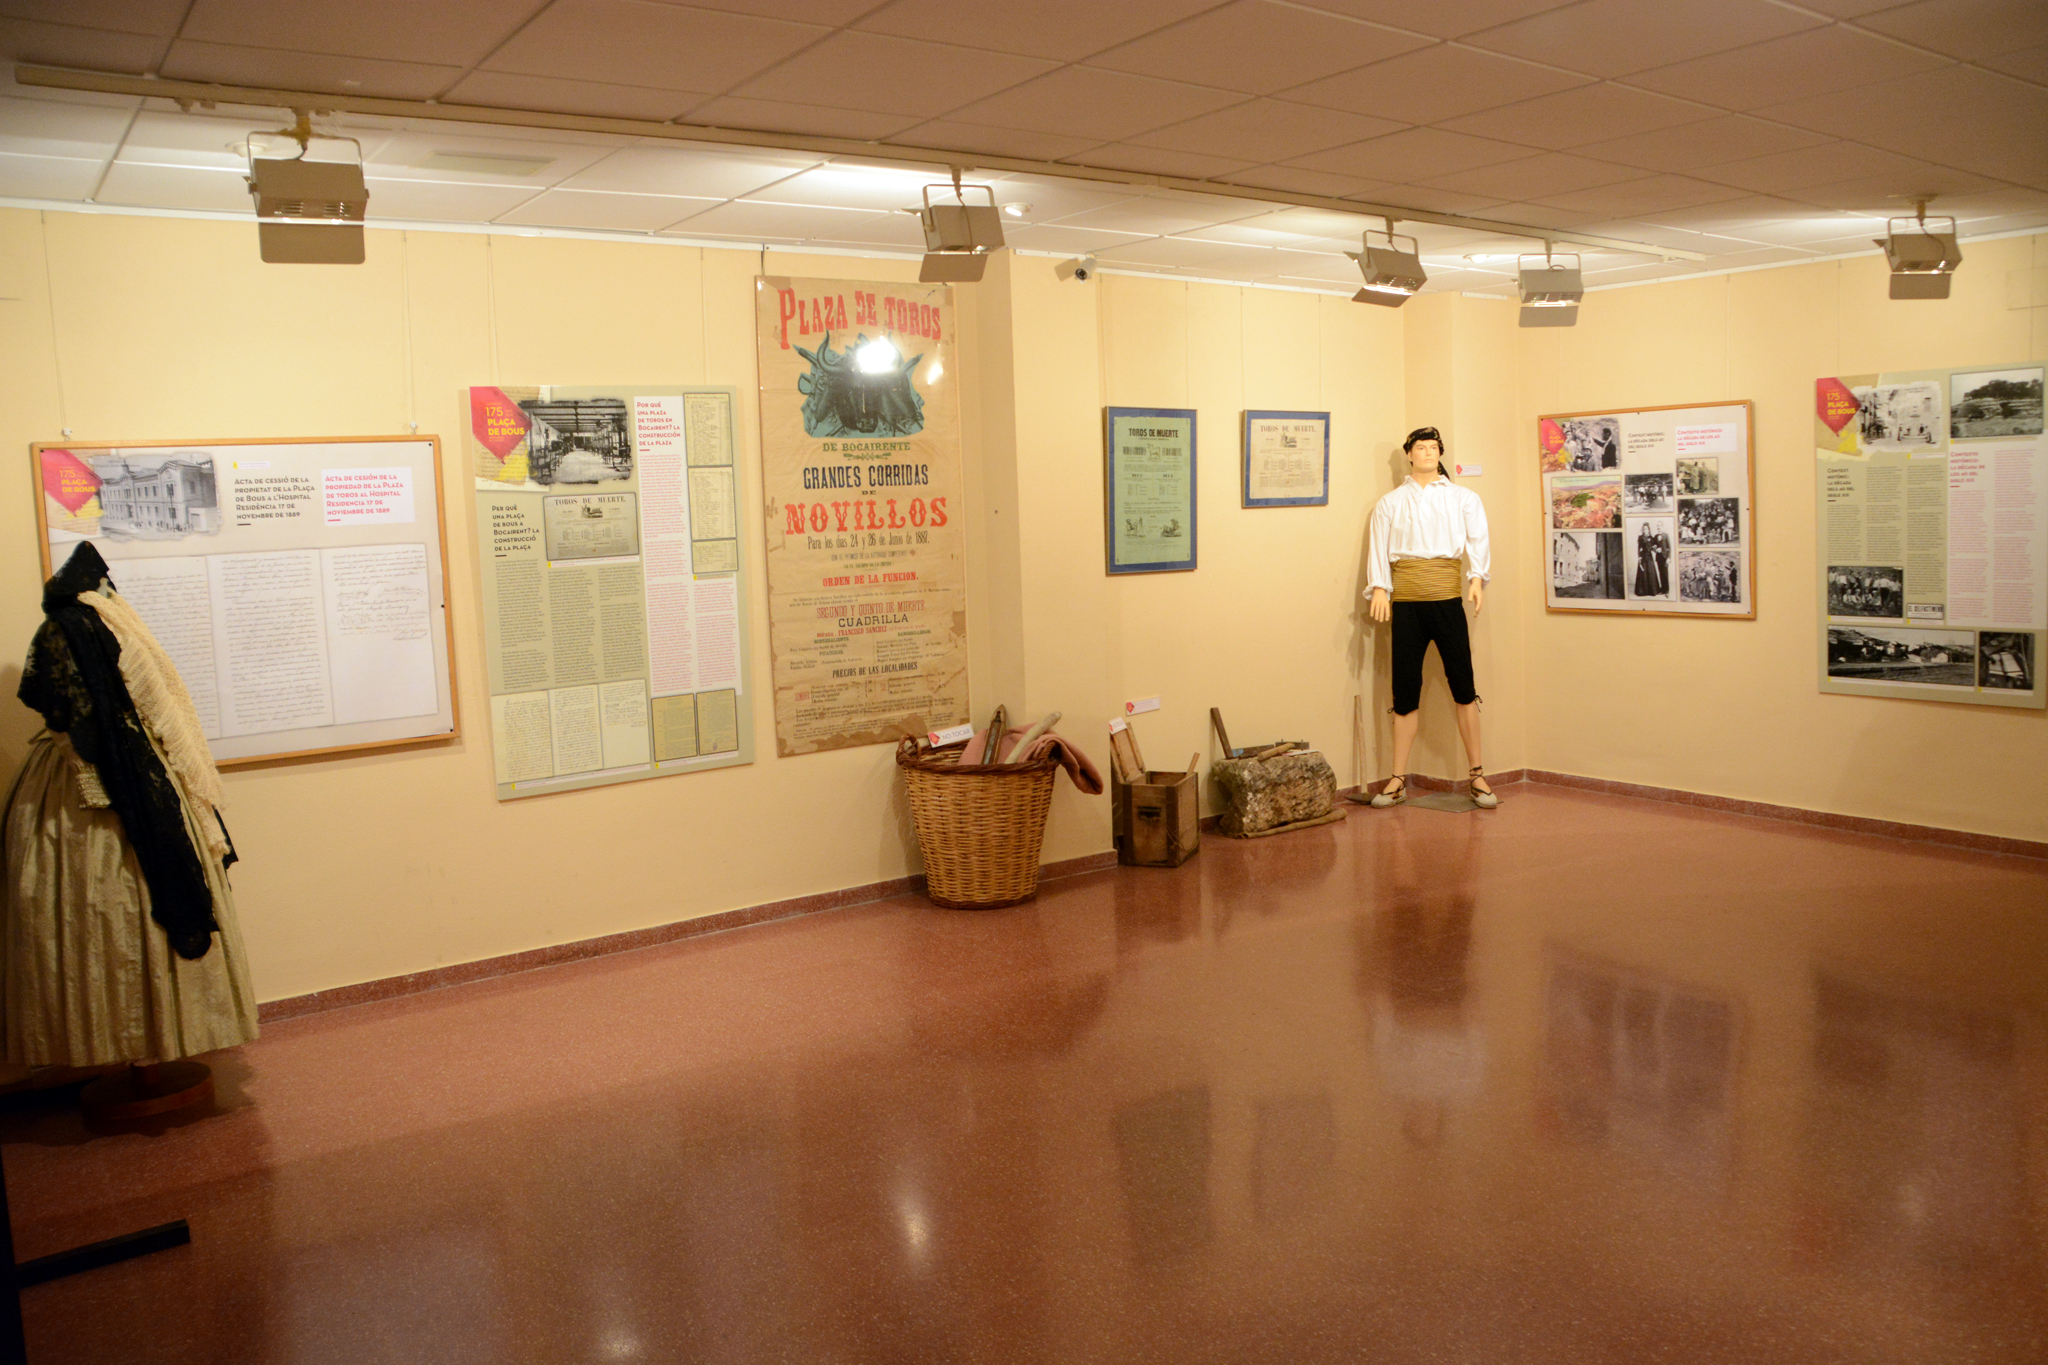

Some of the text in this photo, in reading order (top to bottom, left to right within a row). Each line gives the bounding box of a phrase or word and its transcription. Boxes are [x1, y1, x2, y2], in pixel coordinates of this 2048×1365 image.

[780, 288, 941, 349] PLAZA DE TOROS
[1827, 392, 1841, 401] 175
[485, 406, 504, 417] 175
[1837, 407, 1856, 415] BOUS
[487, 418, 516, 427] PLAÇA
[488, 427, 525, 436] DE BOUS
[1129, 428, 1179, 438] TOROS DE MUERTE
[823, 442, 910, 451] DE BOCAIRENTE
[59, 469, 76, 478] 175
[354, 473, 378, 481] CESIÓN
[803, 464, 929, 489] GRANDES CORRIDAS
[265, 476, 289, 484] CESSIÓ
[293, 484, 315, 493] PLAÇA
[236, 503, 276, 511] RESIDÈNCIA
[506, 513, 525, 521] PLAÇA
[785, 497, 948, 535] NOVILLOS
[493, 528, 531, 536] BOCAIRENT?
[494, 535, 537, 544] CONSTRUCCIÓ
[808, 536, 821, 549] Para
[825, 535, 833, 548] los
[851, 534, 859, 547] 24
[862, 537, 866, 550] y
[868, 533, 876, 546] 26
[879, 533, 885, 545] de
[889, 532, 903, 546] Junio
[906, 532, 912, 545] de
[512, 544, 531, 552] PLAÇA
[822, 571, 919, 587] ORDEN DE LA FUNCION.
[816, 605, 848, 619] SEGUNDO
[851, 604, 856, 614] Y
[858, 602, 884, 616] QUINTO
[886, 601, 895, 613] DE
[838, 613, 909, 628] CUADRILLA
[838, 626, 887, 637] FRANCISCO SANCHEZ
[832, 662, 918, 679] PRECIOS DE LAS LOCALIDADES
[952, 728, 970, 737] TOCAR
